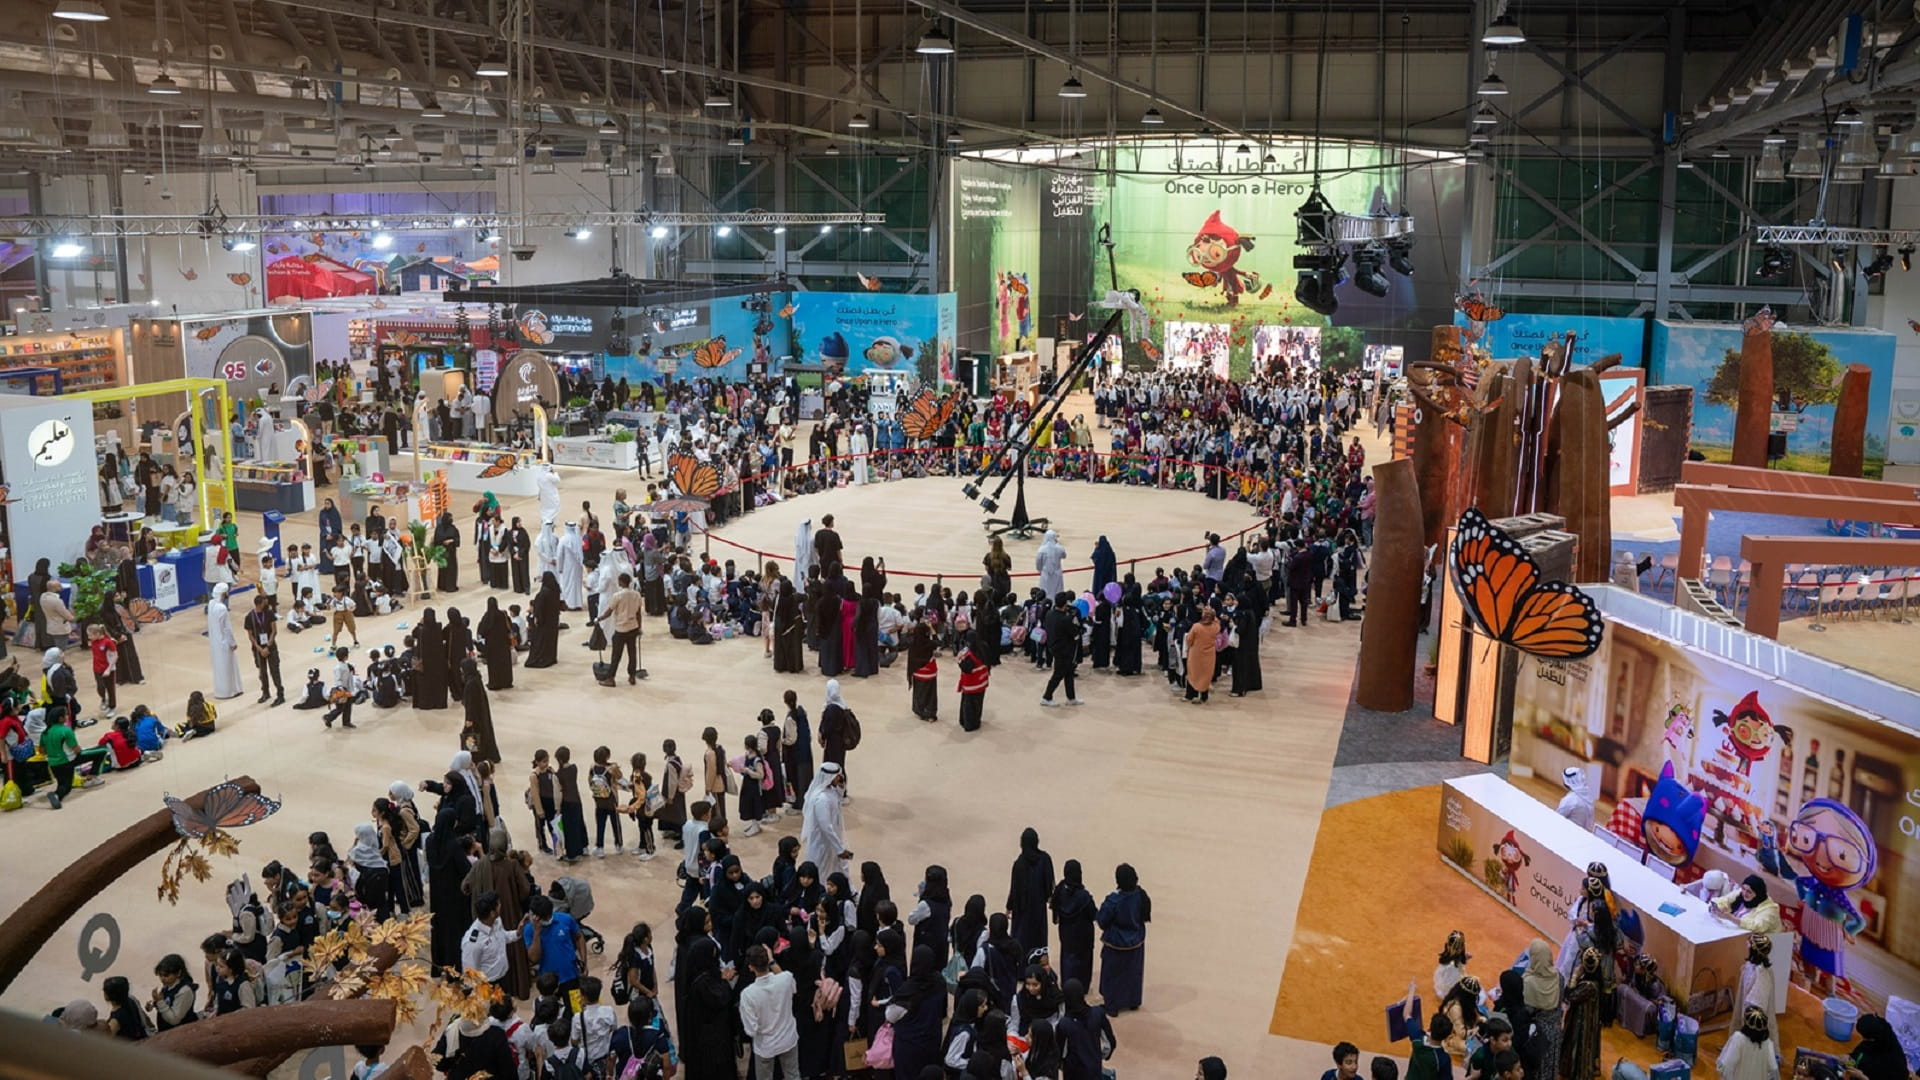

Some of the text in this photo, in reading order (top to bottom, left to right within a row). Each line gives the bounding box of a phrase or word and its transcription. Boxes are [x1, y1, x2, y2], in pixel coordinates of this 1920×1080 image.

[1165, 180, 1304, 198] Once Upon a Hero
[836, 317, 854, 326] Once
[855, 318, 873, 327] Upon
[881, 318, 898, 327] Hero
[1511, 341, 1534, 352] Once
[221, 361, 247, 382] 95
[1530, 886, 1551, 908] Once
[78, 913, 121, 982] Q
